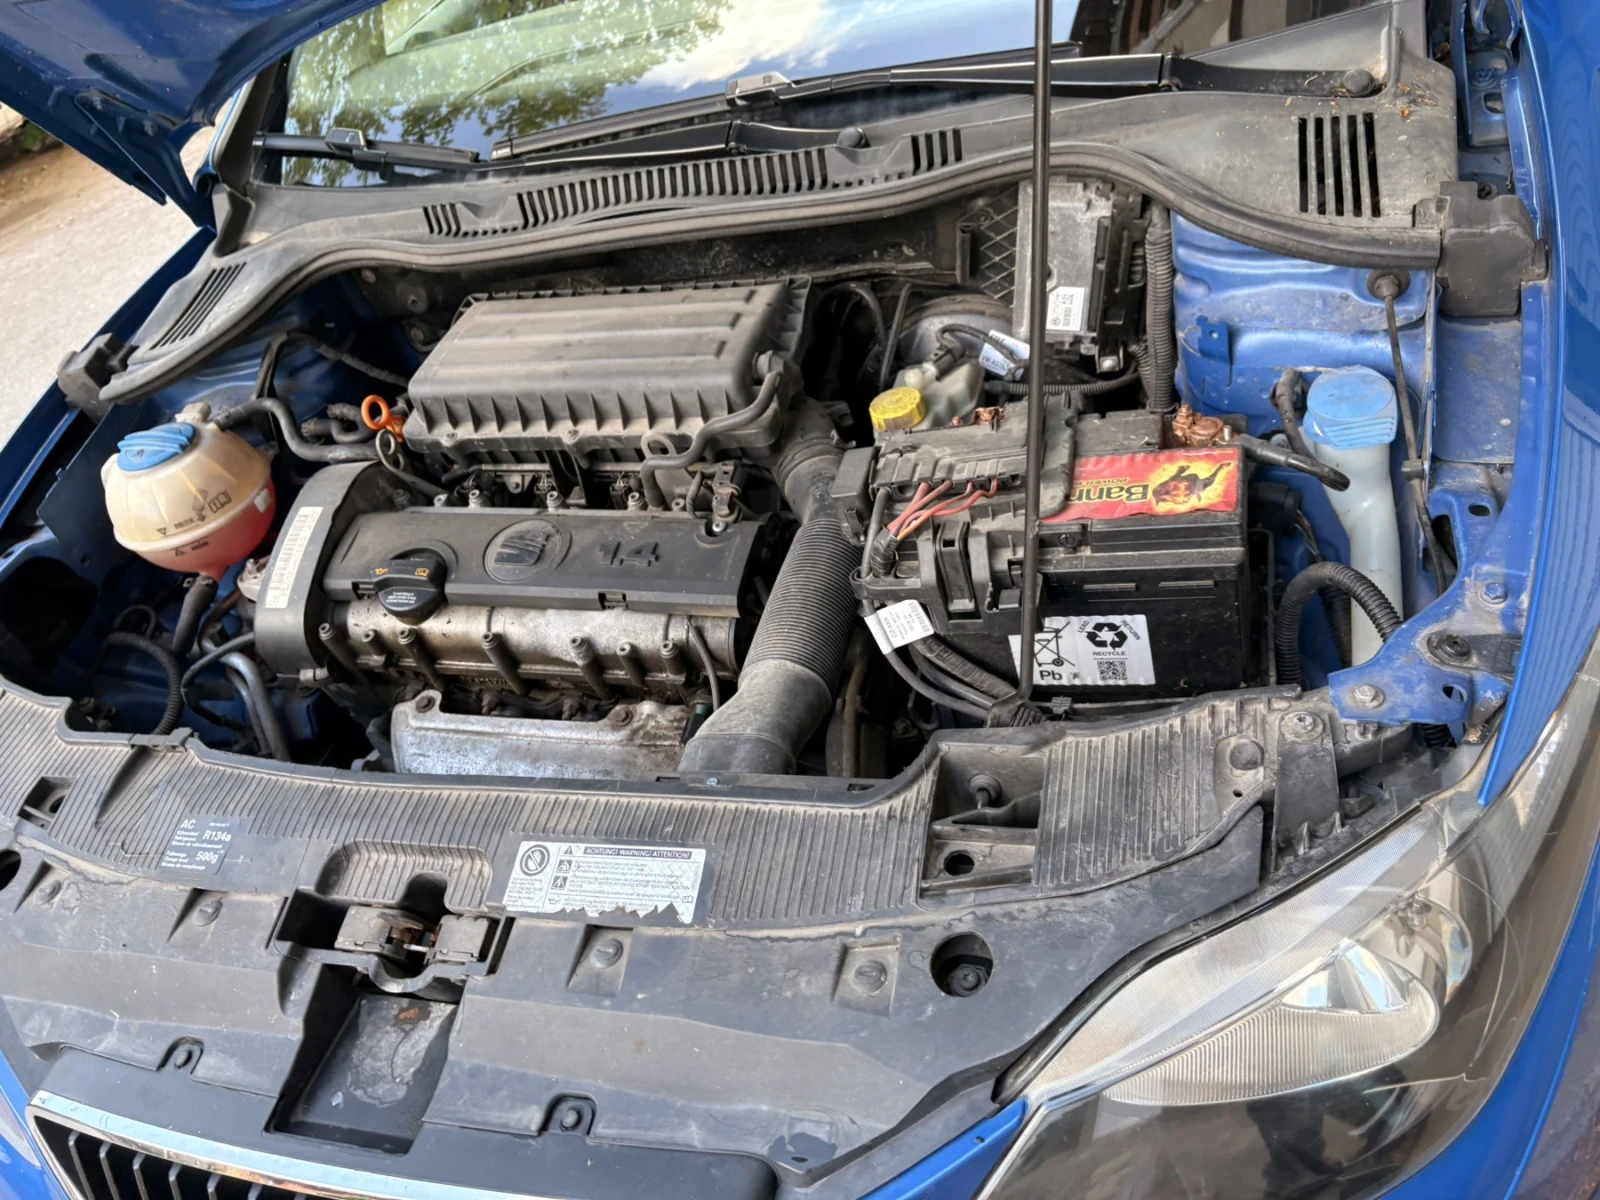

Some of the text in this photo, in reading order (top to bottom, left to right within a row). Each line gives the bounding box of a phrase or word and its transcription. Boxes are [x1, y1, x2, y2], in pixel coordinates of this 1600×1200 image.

[1068, 484, 1149, 502] Bann
[174, 518, 194, 529] max
[191, 541, 209, 551] min
[1078, 620, 1090, 633] LEAD
[1120, 619, 1142, 641] RETURN
[1039, 670, 1063, 681] Pb
[180, 819, 196, 829] AC
[202, 830, 232, 842] R134a
[195, 851, 219, 864] 500g
[585, 847, 690, 859] ACHTUNG! WARNING! ATTENTION!
